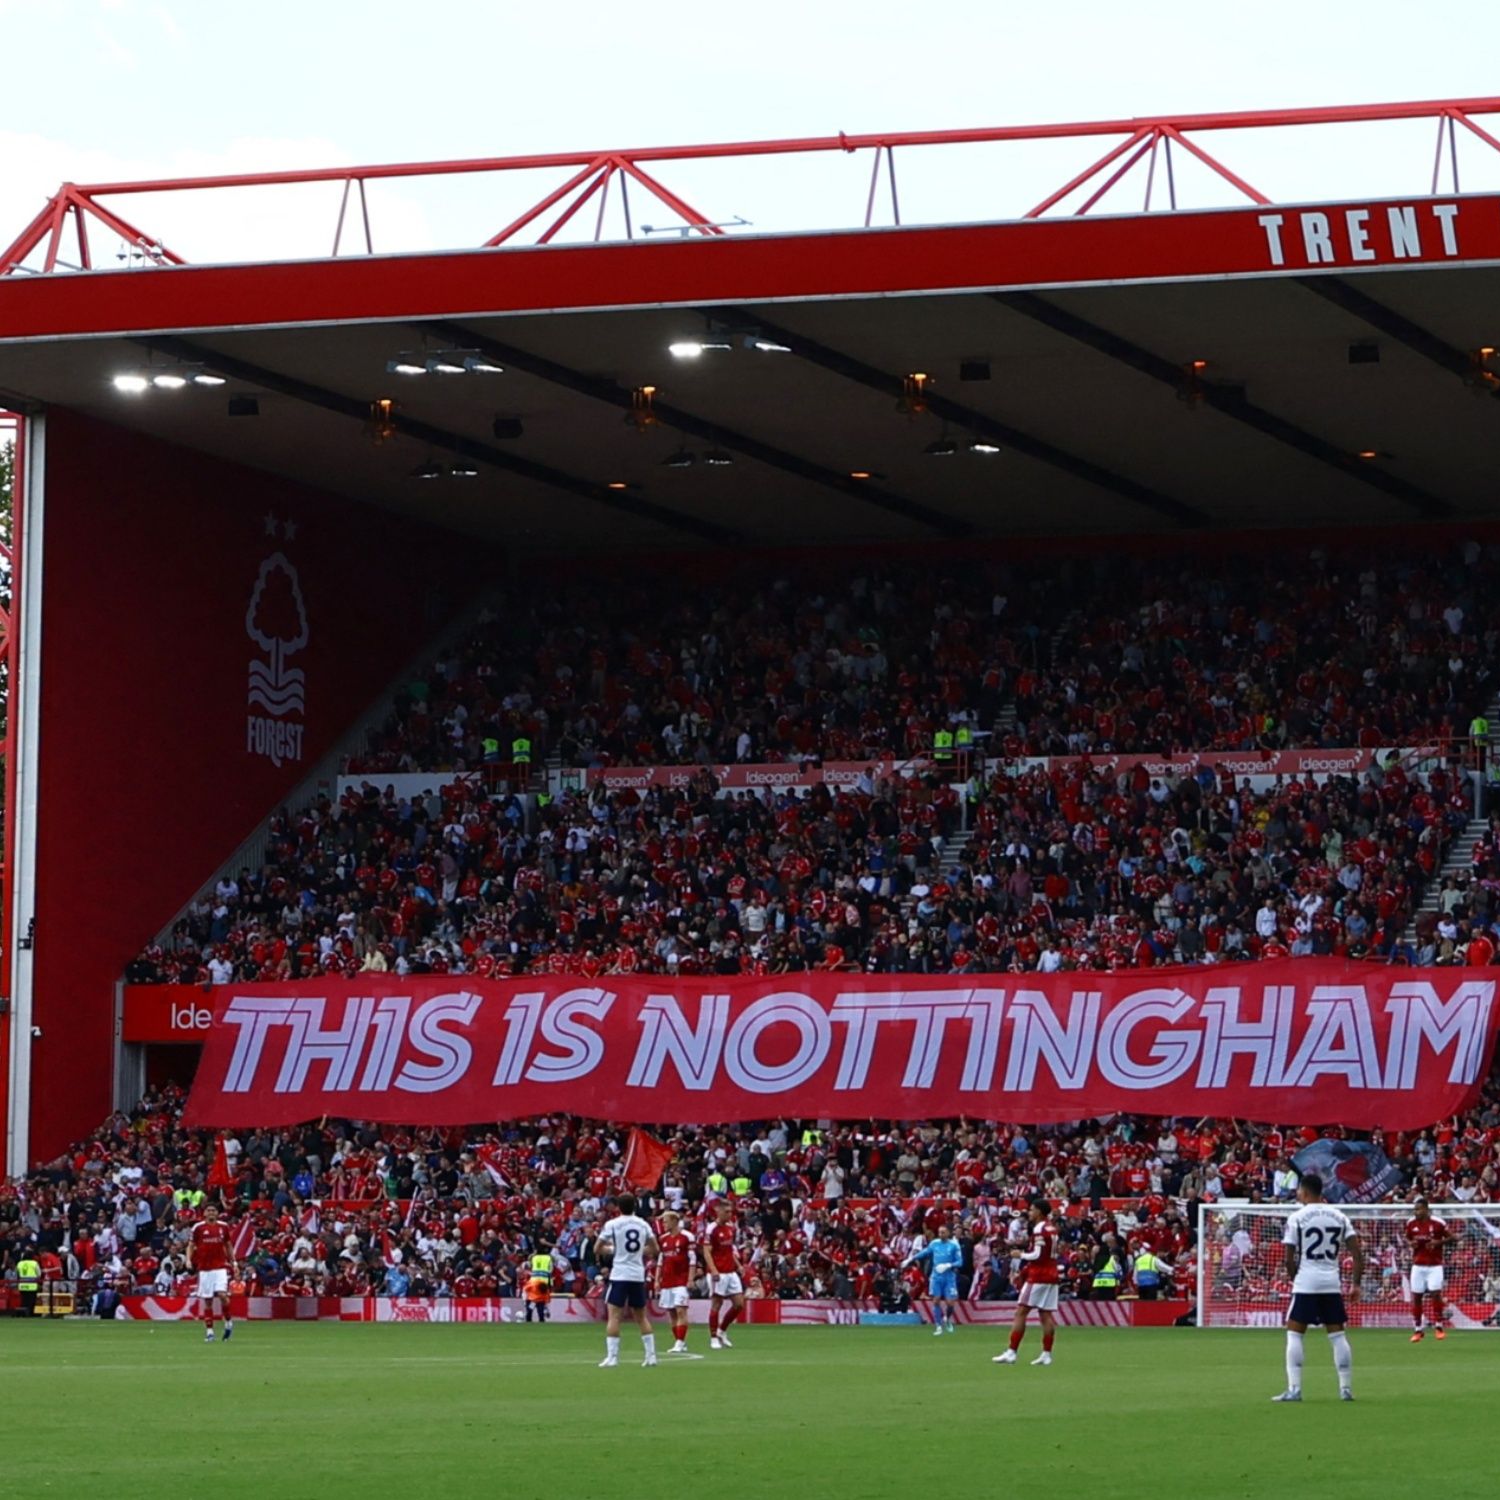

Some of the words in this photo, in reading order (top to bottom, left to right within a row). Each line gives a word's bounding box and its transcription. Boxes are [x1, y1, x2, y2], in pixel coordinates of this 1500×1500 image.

[1257, 204, 1459, 265] TRENT
[746, 771, 799, 786] Ideagen
[1299, 757, 1355, 772] Ideagen
[221, 991, 484, 1093] THIS
[492, 987, 618, 1087] IS
[626, 980, 1496, 1094] NOTTINGHAM
[625, 1229, 641, 1253] 8
[1305, 1226, 1342, 1260] 23
